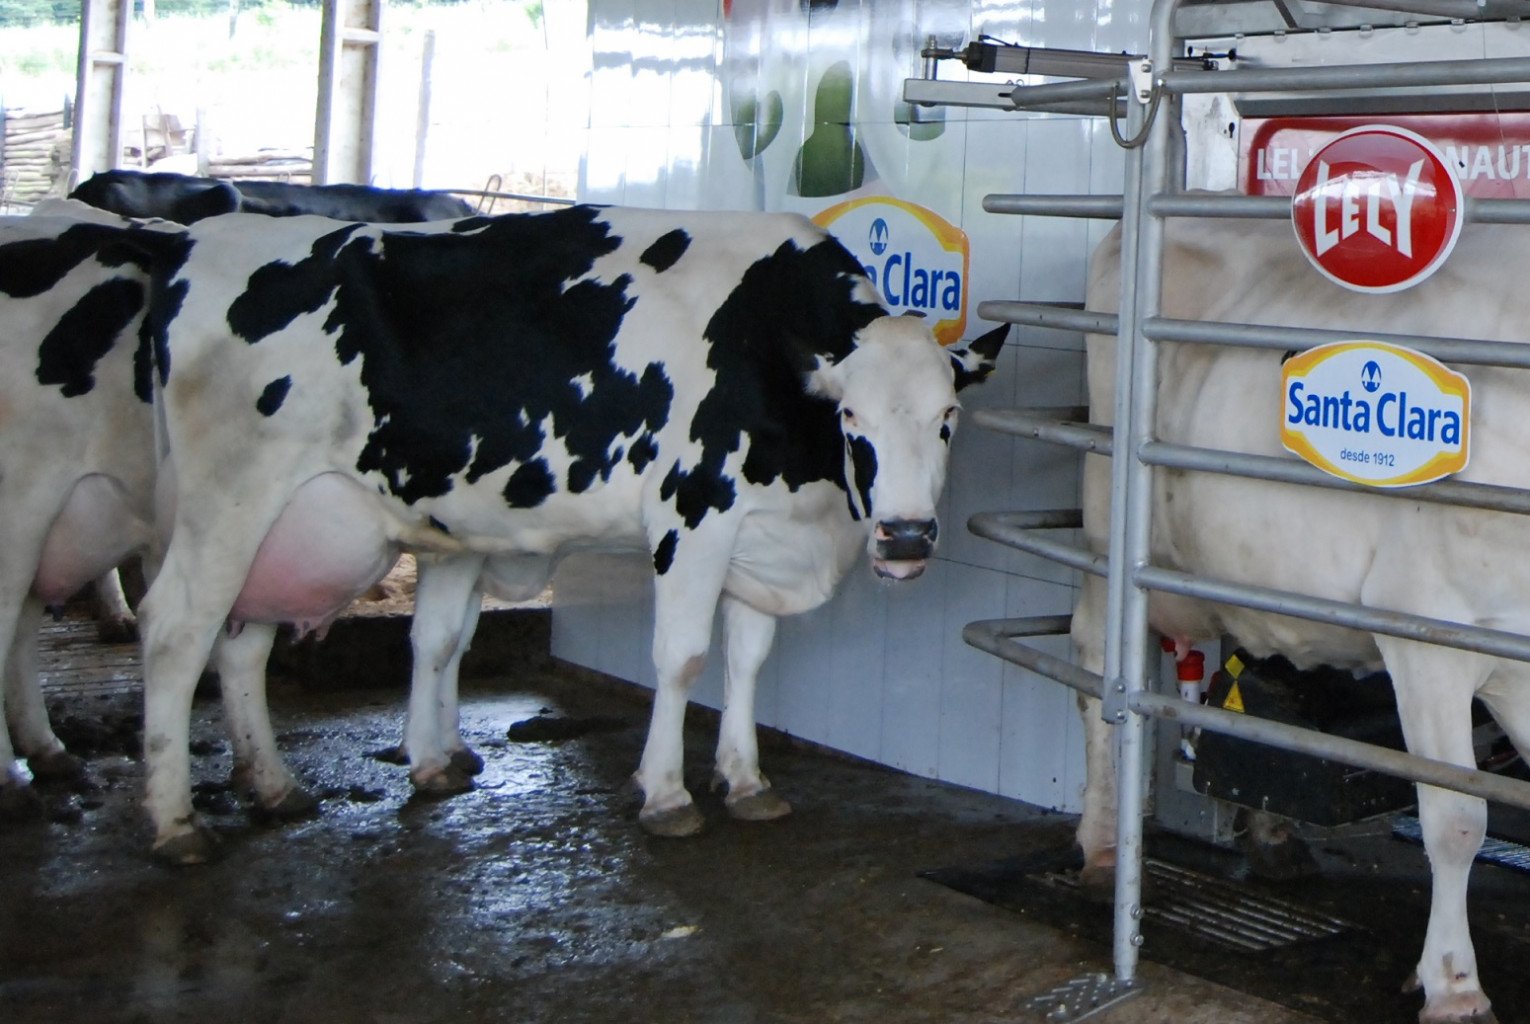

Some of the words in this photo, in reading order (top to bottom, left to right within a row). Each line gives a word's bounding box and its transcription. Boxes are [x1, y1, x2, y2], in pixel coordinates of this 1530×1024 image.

[1314, 158, 1425, 259] LELY
[882, 250, 961, 312] Clara
[1288, 381, 1370, 434] Santa
[1376, 392, 1461, 446] Clara
[1339, 447, 1370, 465] desde
[1373, 450, 1396, 468] 1912
